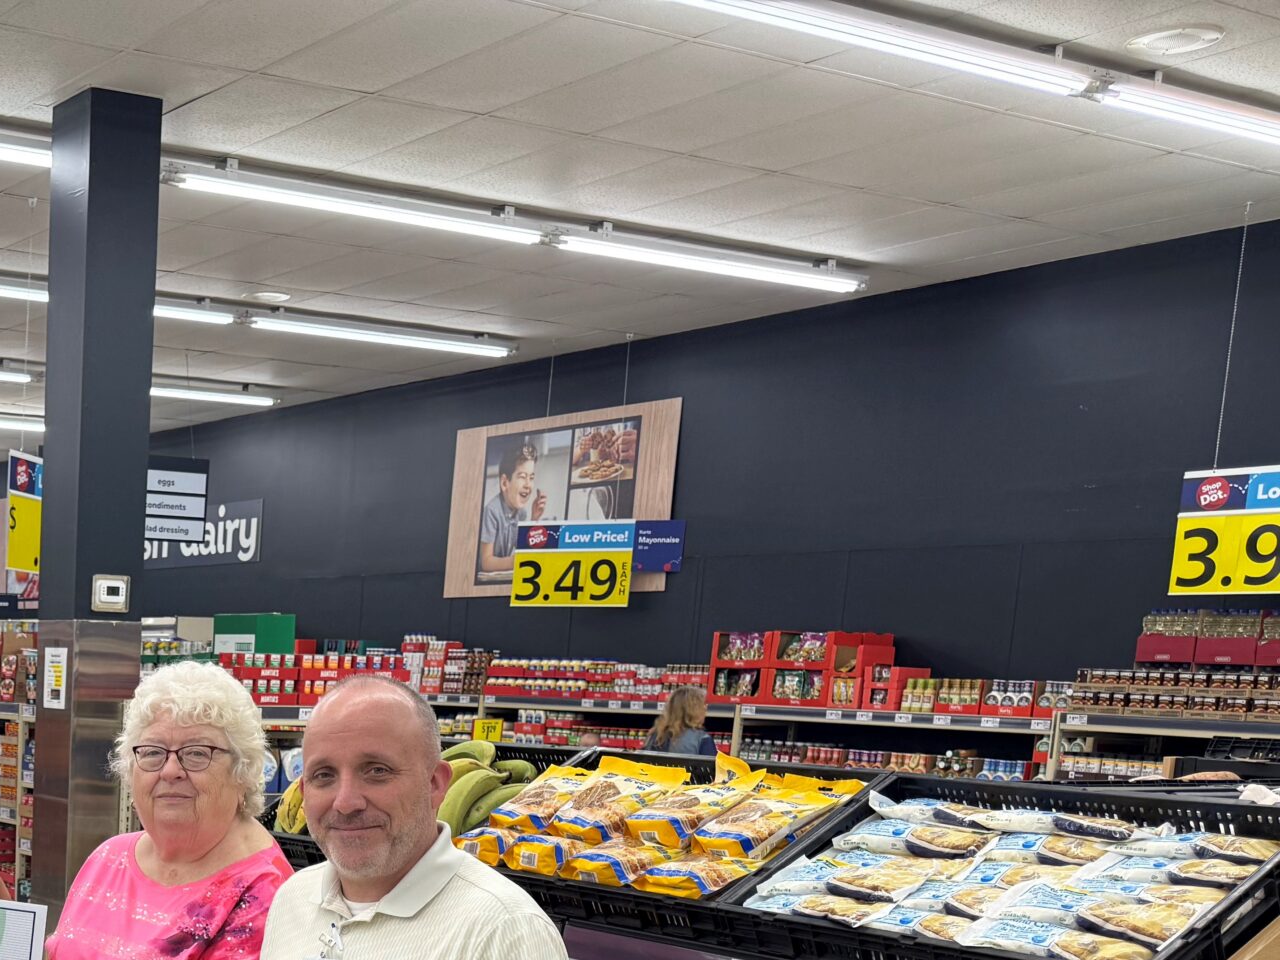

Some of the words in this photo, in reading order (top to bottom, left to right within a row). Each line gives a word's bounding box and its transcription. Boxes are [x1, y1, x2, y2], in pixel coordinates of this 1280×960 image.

[158, 478, 175, 487] eggs
[1201, 482, 1222, 493] Shop
[1257, 484, 1280, 499] Lo
[1200, 491, 1228, 506] Dot.
[159, 525, 189, 535] dressing
[565, 531, 590, 543] Low
[593, 530, 629, 543] Price!
[638, 536, 680, 545] Mayonnaise
[1175, 524, 1280, 588] 3.9
[514, 559, 617, 601] 3.49
[619, 562, 627, 596] EACH
